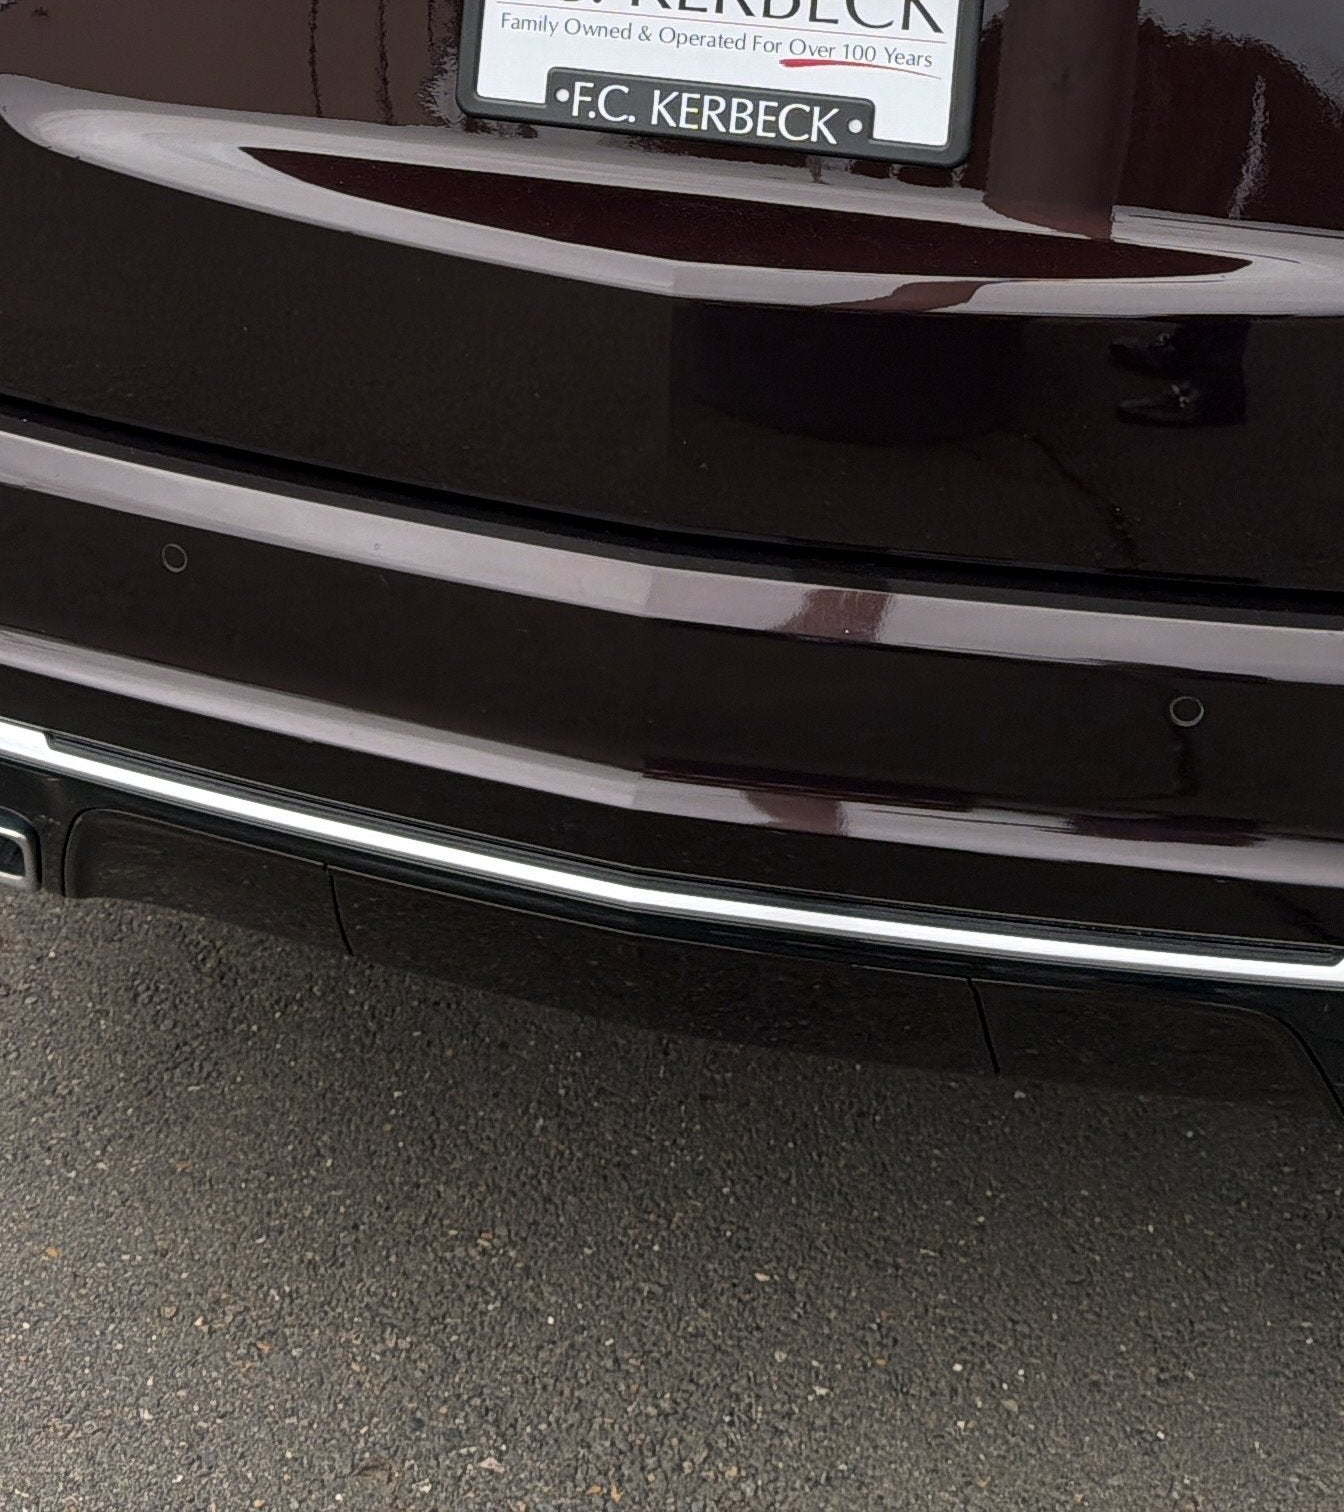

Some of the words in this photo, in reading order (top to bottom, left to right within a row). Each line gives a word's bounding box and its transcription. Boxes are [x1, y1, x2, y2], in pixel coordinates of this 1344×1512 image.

[500, 11, 559, 37] Family
[563, 17, 632, 41] Owned
[637, 24, 652, 42] &
[659, 26, 747, 56] Operated
[752, 34, 783, 54] For
[788, 38, 836, 60] Over
[842, 43, 877, 63] 100
[883, 45, 933, 68] Years
[571, 82, 636, 123] F.C.
[650, 89, 840, 145] KERBECK
